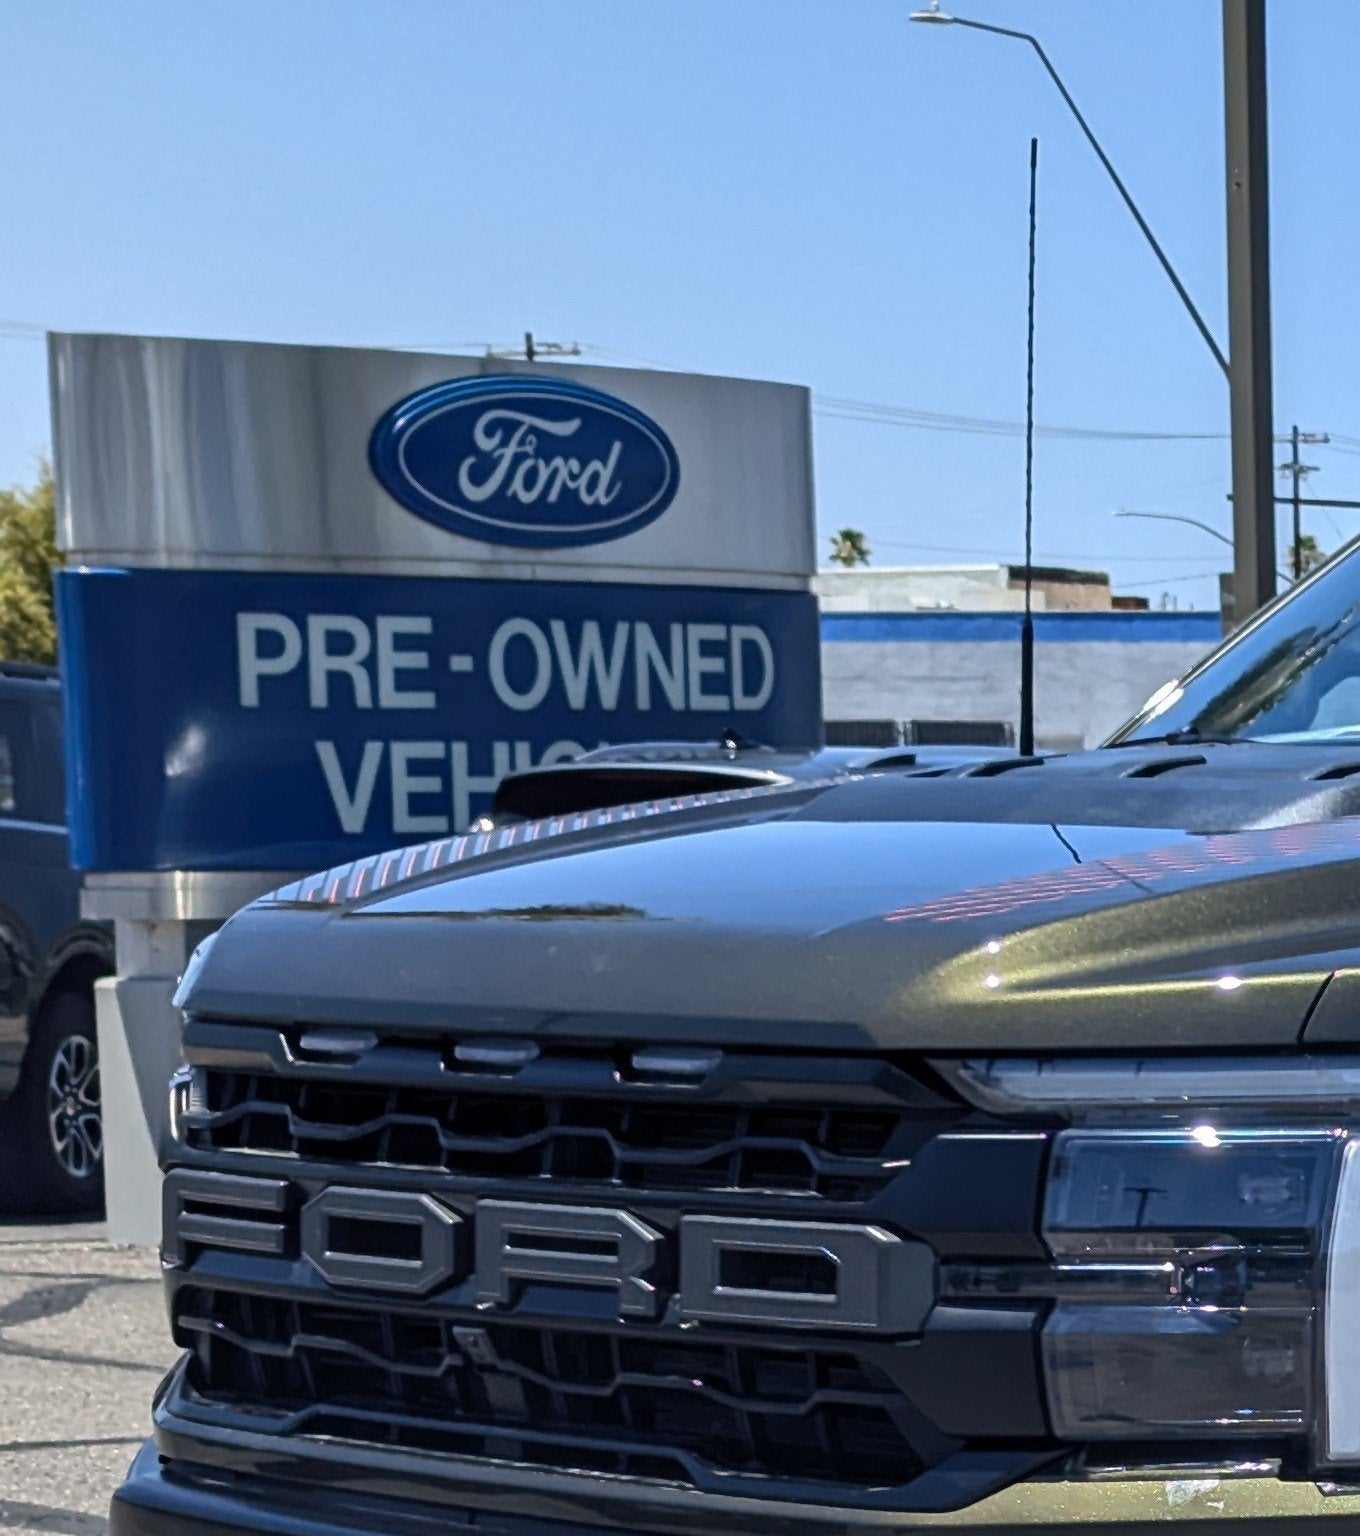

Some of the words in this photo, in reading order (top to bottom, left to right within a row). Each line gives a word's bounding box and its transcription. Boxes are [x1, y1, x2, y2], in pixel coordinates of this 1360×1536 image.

[458, 409, 622, 506] Ford
[314, 740, 592, 834] VEH
[162, 1166, 938, 1334] FORD
